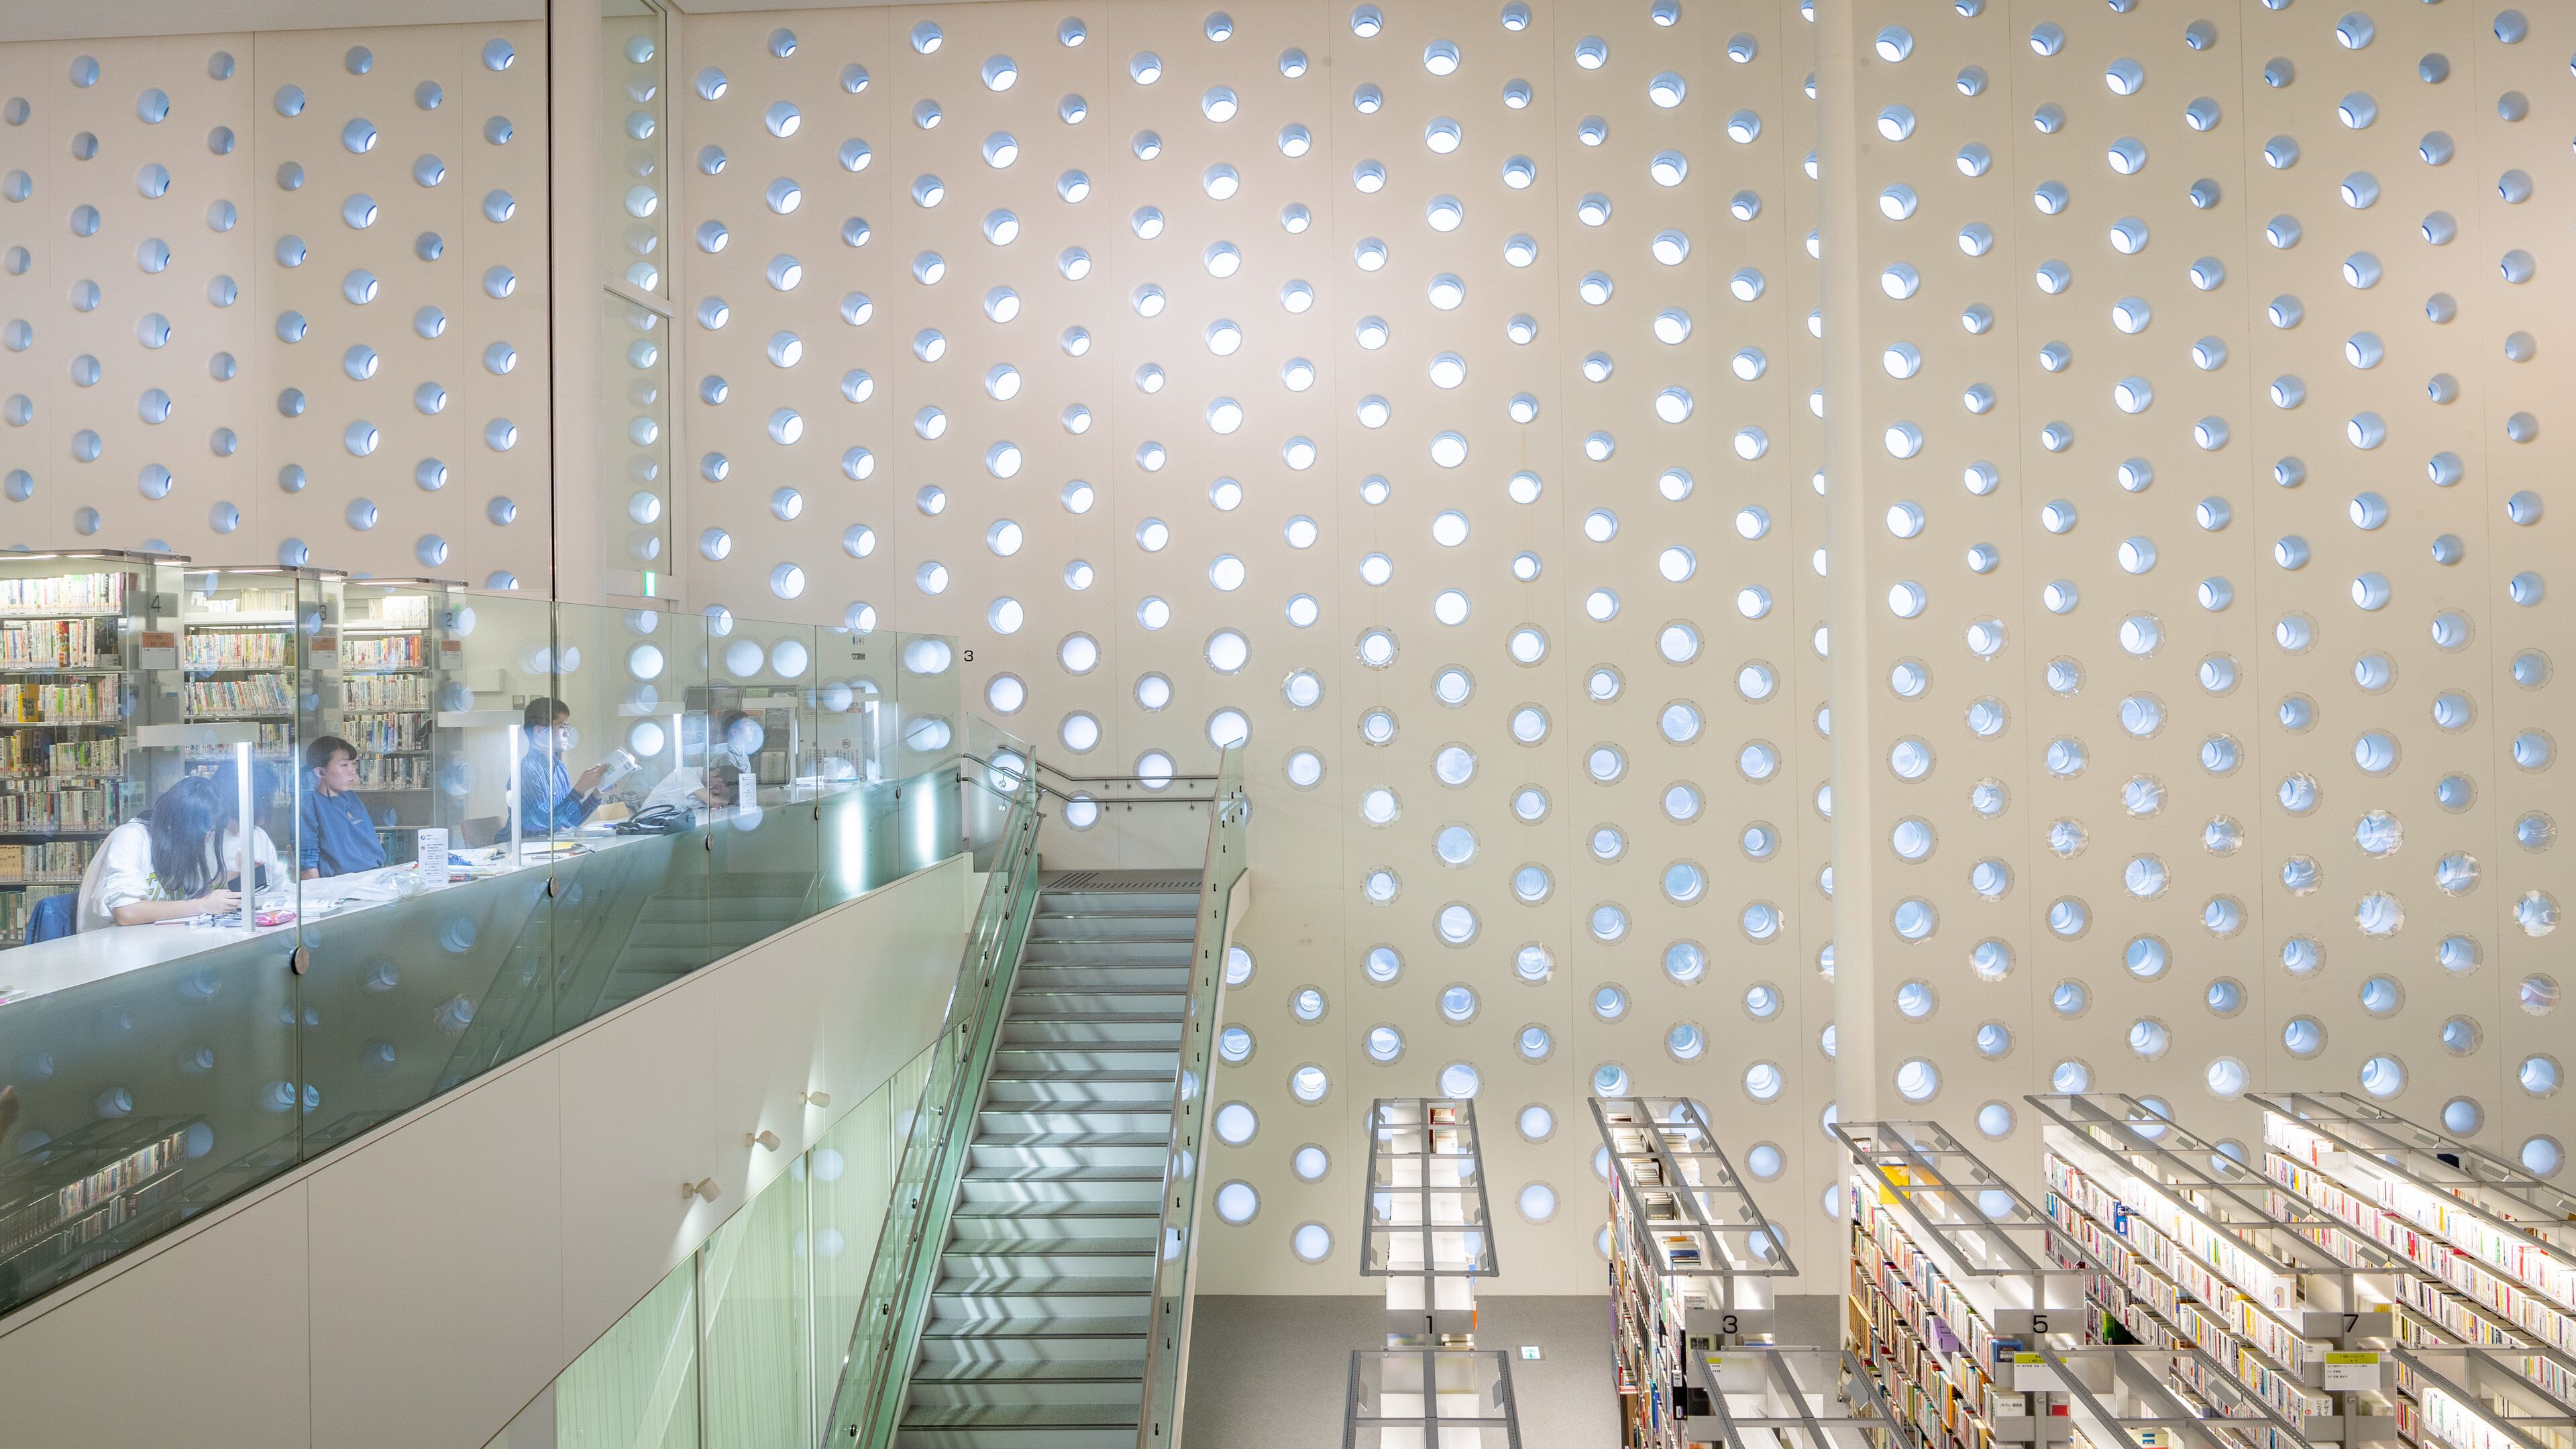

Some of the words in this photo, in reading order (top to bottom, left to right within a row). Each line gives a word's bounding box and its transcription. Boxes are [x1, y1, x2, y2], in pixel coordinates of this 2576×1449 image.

[151, 595, 161, 613] 4
[320, 604, 327, 621] 3
[445, 612, 453, 627] 2
[964, 650, 973, 661] 3
[1426, 1316, 1433, 1334] 1
[1723, 1315, 1738, 1334] 3
[2033, 1315, 2048, 1334] 5
[2343, 1313, 2359, 1333] 7
